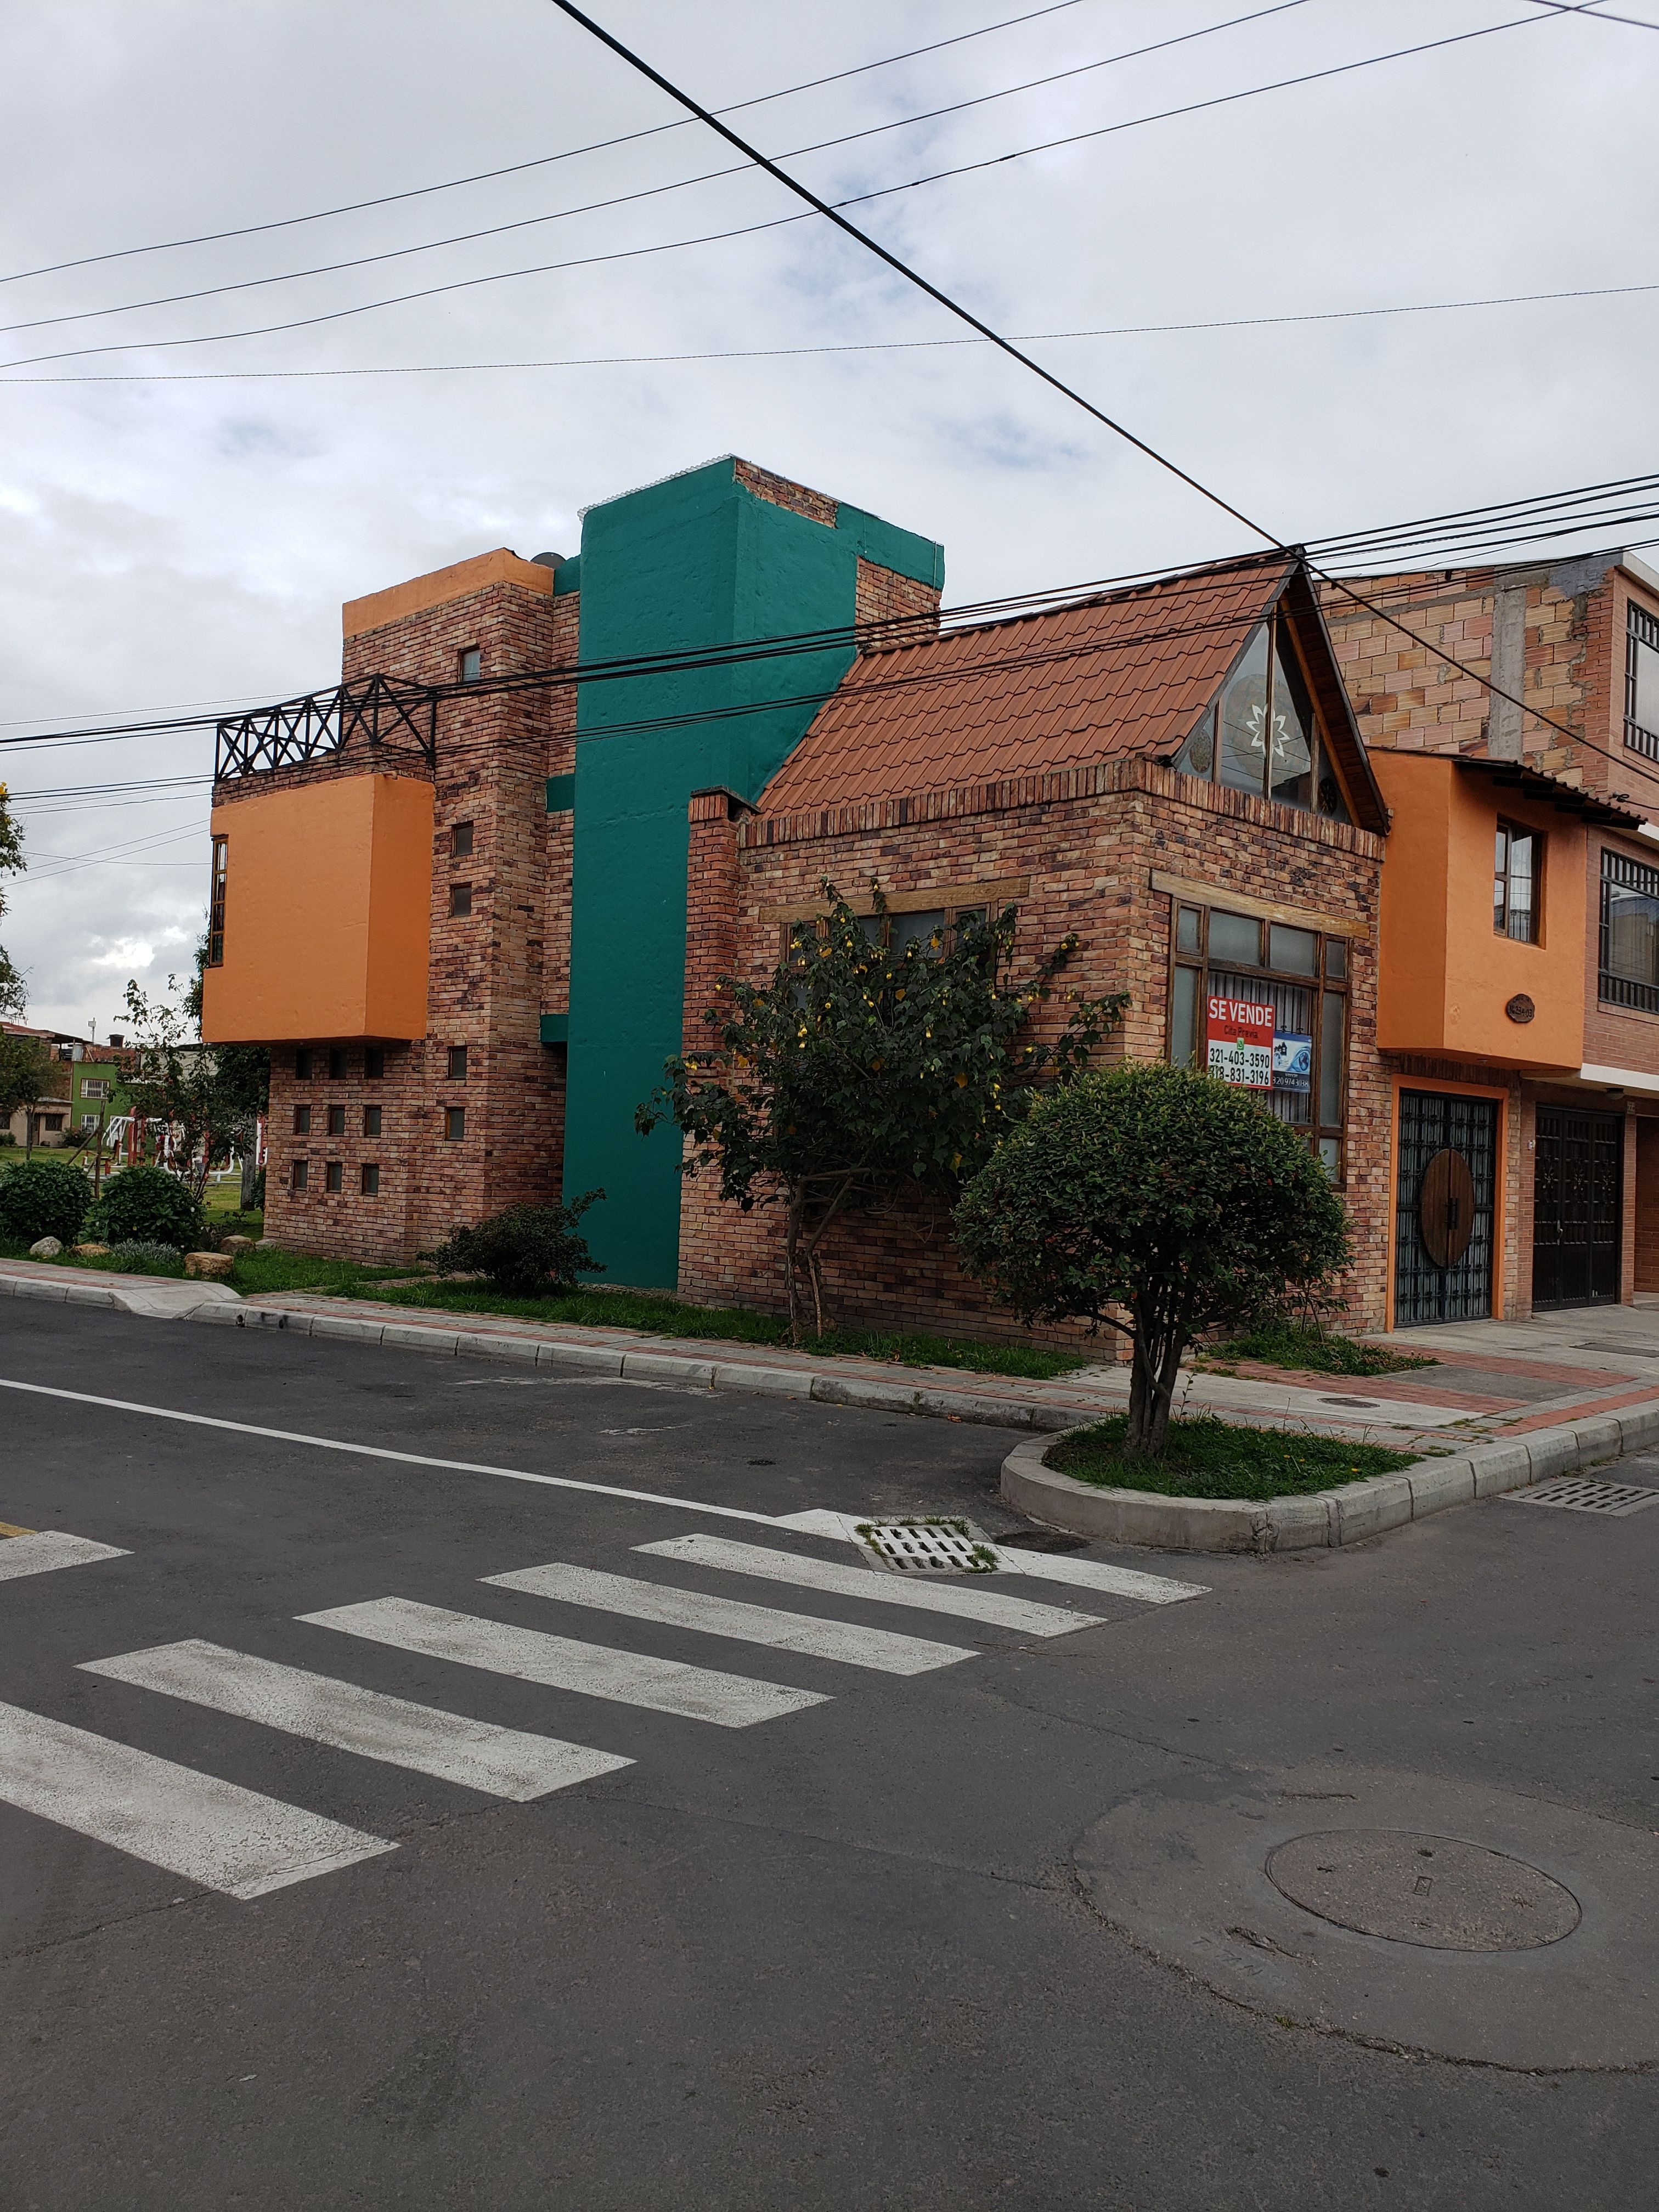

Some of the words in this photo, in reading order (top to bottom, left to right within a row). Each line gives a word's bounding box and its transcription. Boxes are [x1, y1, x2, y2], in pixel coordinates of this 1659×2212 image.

[1209, 999, 1227, 1020] SE
[1229, 1001, 1273, 1027] VENDE
[1224, 1025, 1237, 1035] Cita
[1238, 1027, 1258, 1039] Previa
[1210, 1048, 1269, 1068] 321-403-3590
